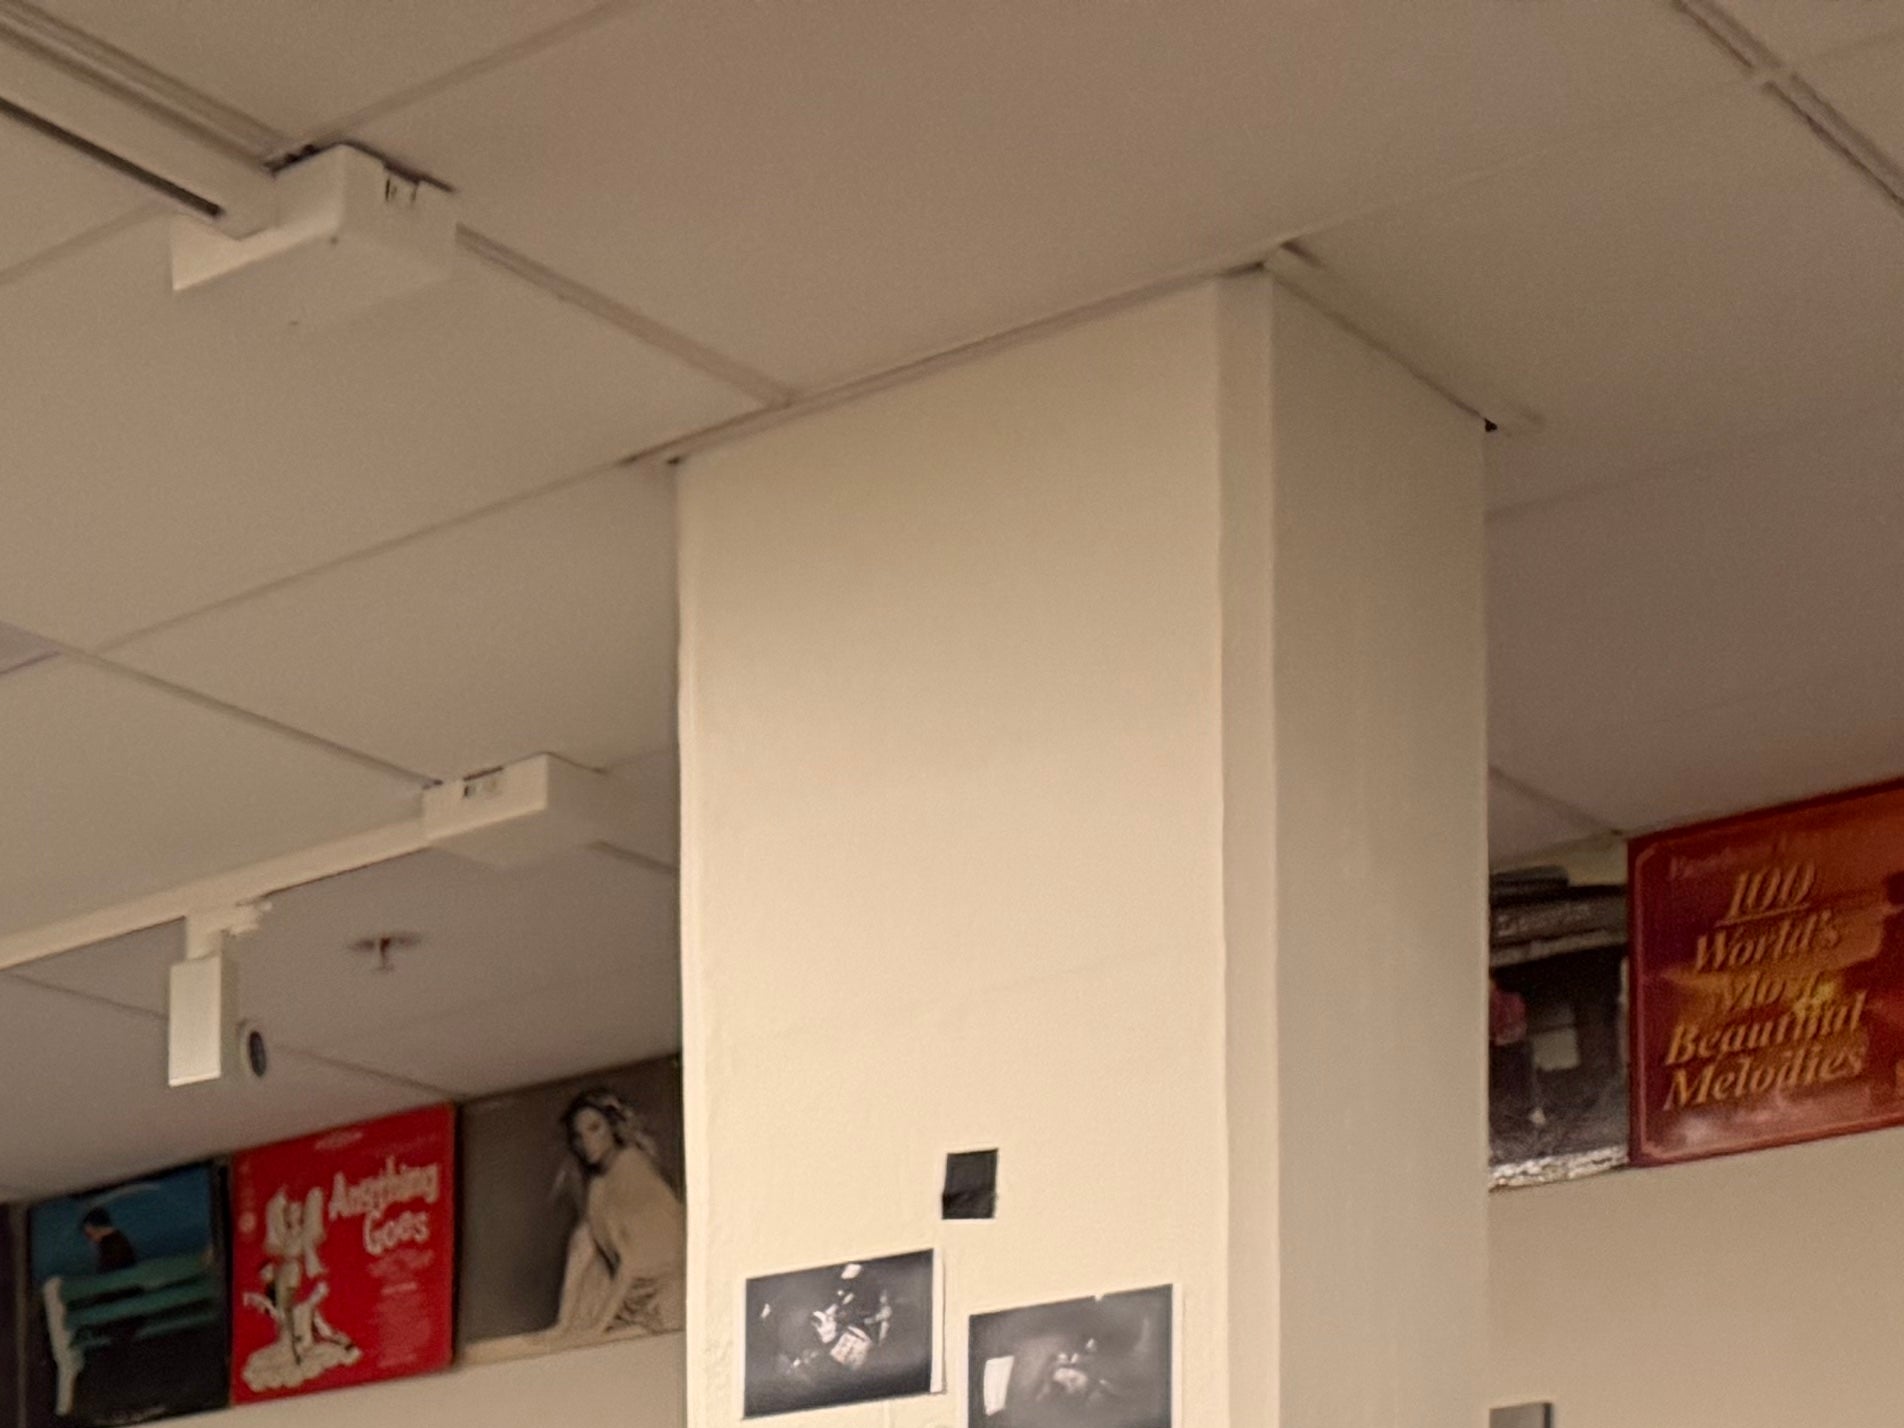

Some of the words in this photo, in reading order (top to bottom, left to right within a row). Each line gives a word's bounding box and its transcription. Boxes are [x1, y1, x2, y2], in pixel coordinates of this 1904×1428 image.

[1695, 910, 1838, 971] World's
[1665, 989, 1868, 1066] Beautiful
[1662, 1045, 1863, 1111] Melodies
[328, 1155, 439, 1221] Anything
[362, 1209, 431, 1256] Goes
